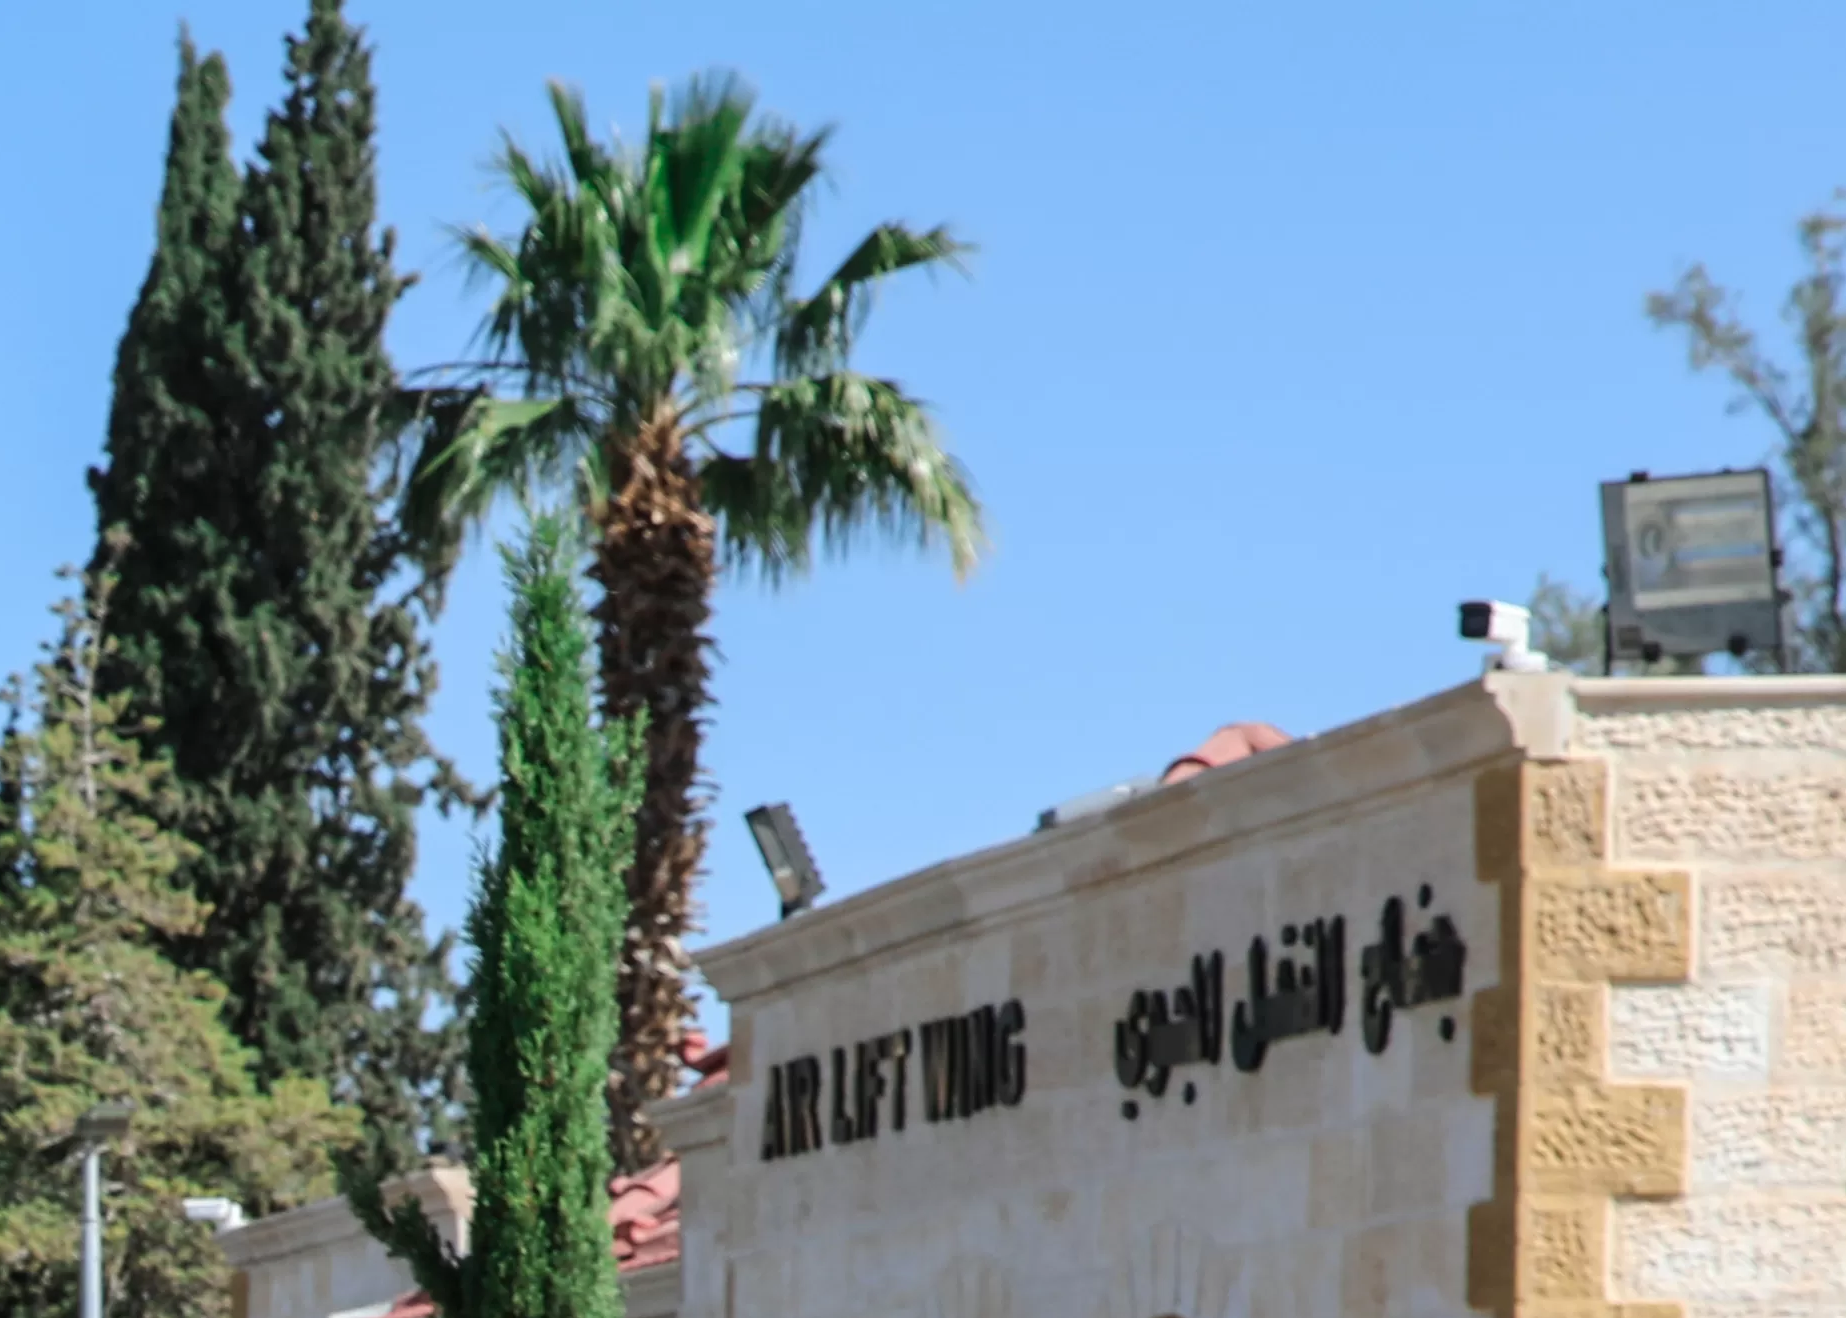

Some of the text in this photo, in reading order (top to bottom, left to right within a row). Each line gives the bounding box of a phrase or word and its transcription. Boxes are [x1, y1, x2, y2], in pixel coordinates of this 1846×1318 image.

[760, 998, 1027, 1163] AIR LIFT WING
[1114, 883, 1467, 1121] جناح النقل الجوي
